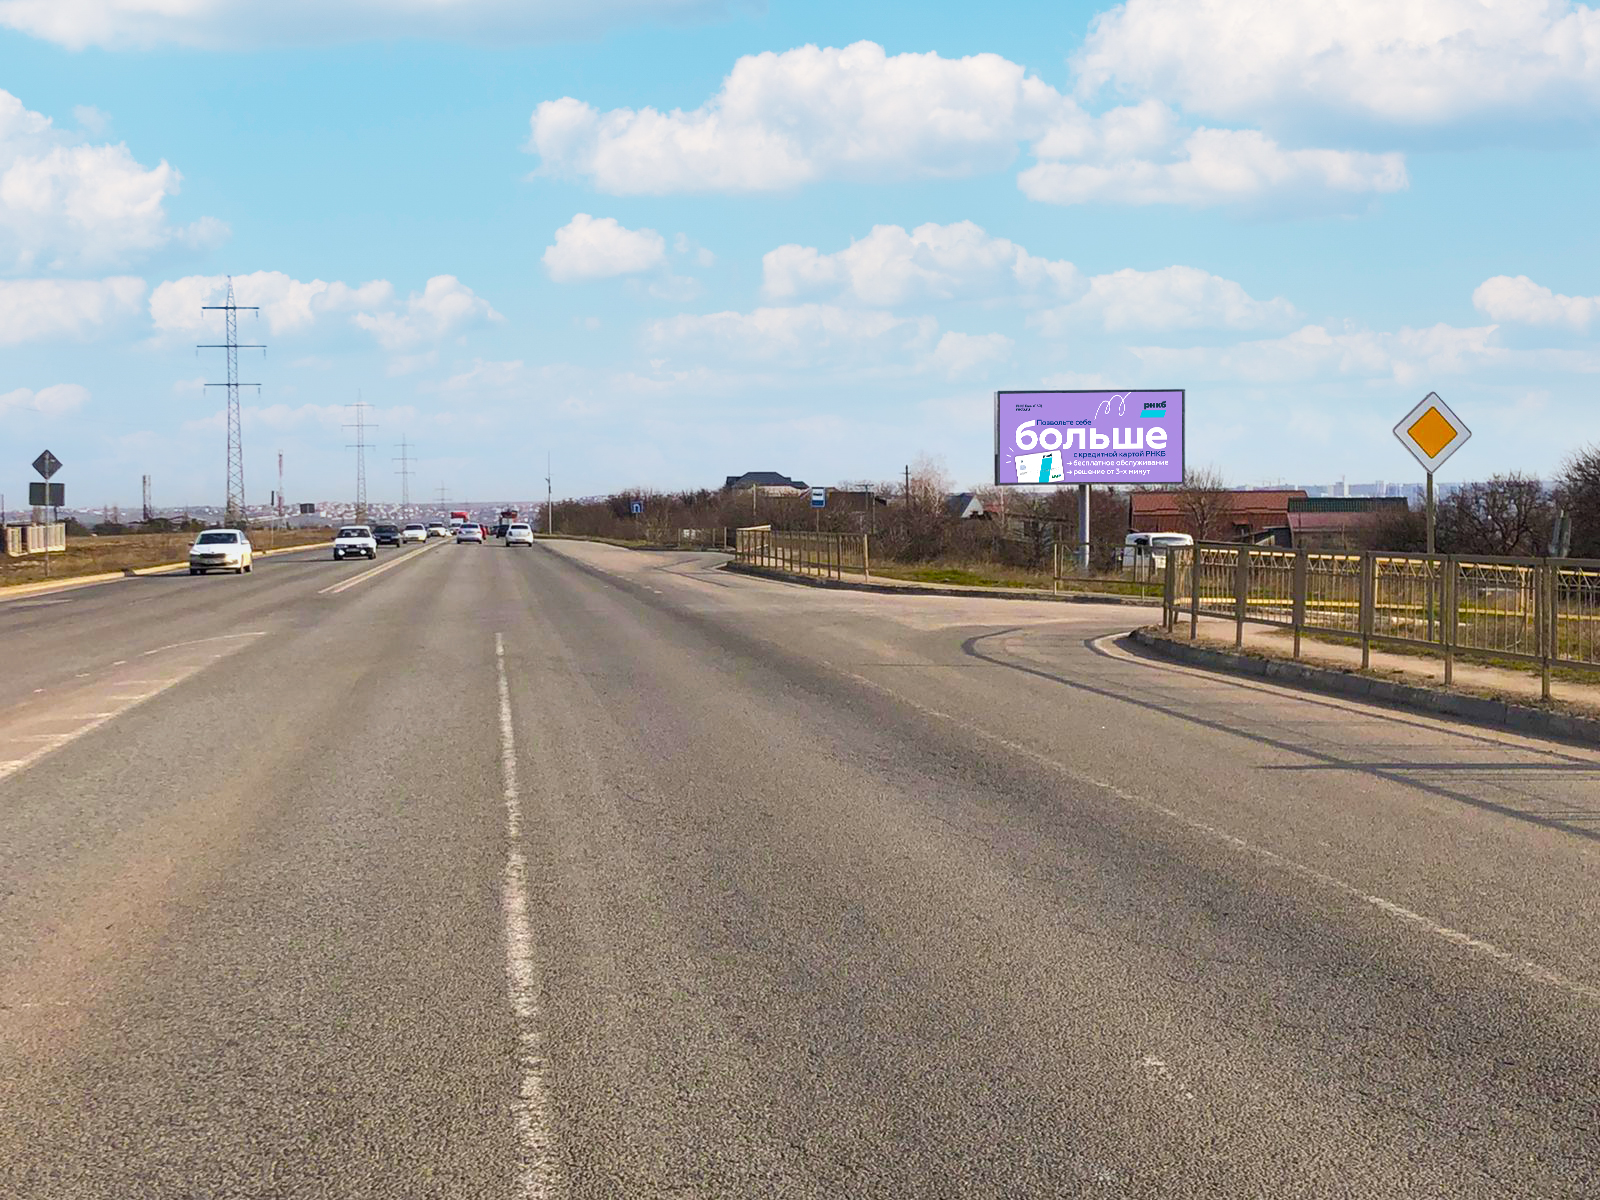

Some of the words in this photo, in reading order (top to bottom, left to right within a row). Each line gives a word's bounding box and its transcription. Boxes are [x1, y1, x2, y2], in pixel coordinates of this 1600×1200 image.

[1143, 400, 1167, 410] рнкб
[1076, 418, 1092, 426] себе
[1015, 419, 1168, 450] больше
[1078, 451, 1118, 459] кредитной
[1119, 450, 1145, 459] картой
[1115, 459, 1169, 467] обслуживание
